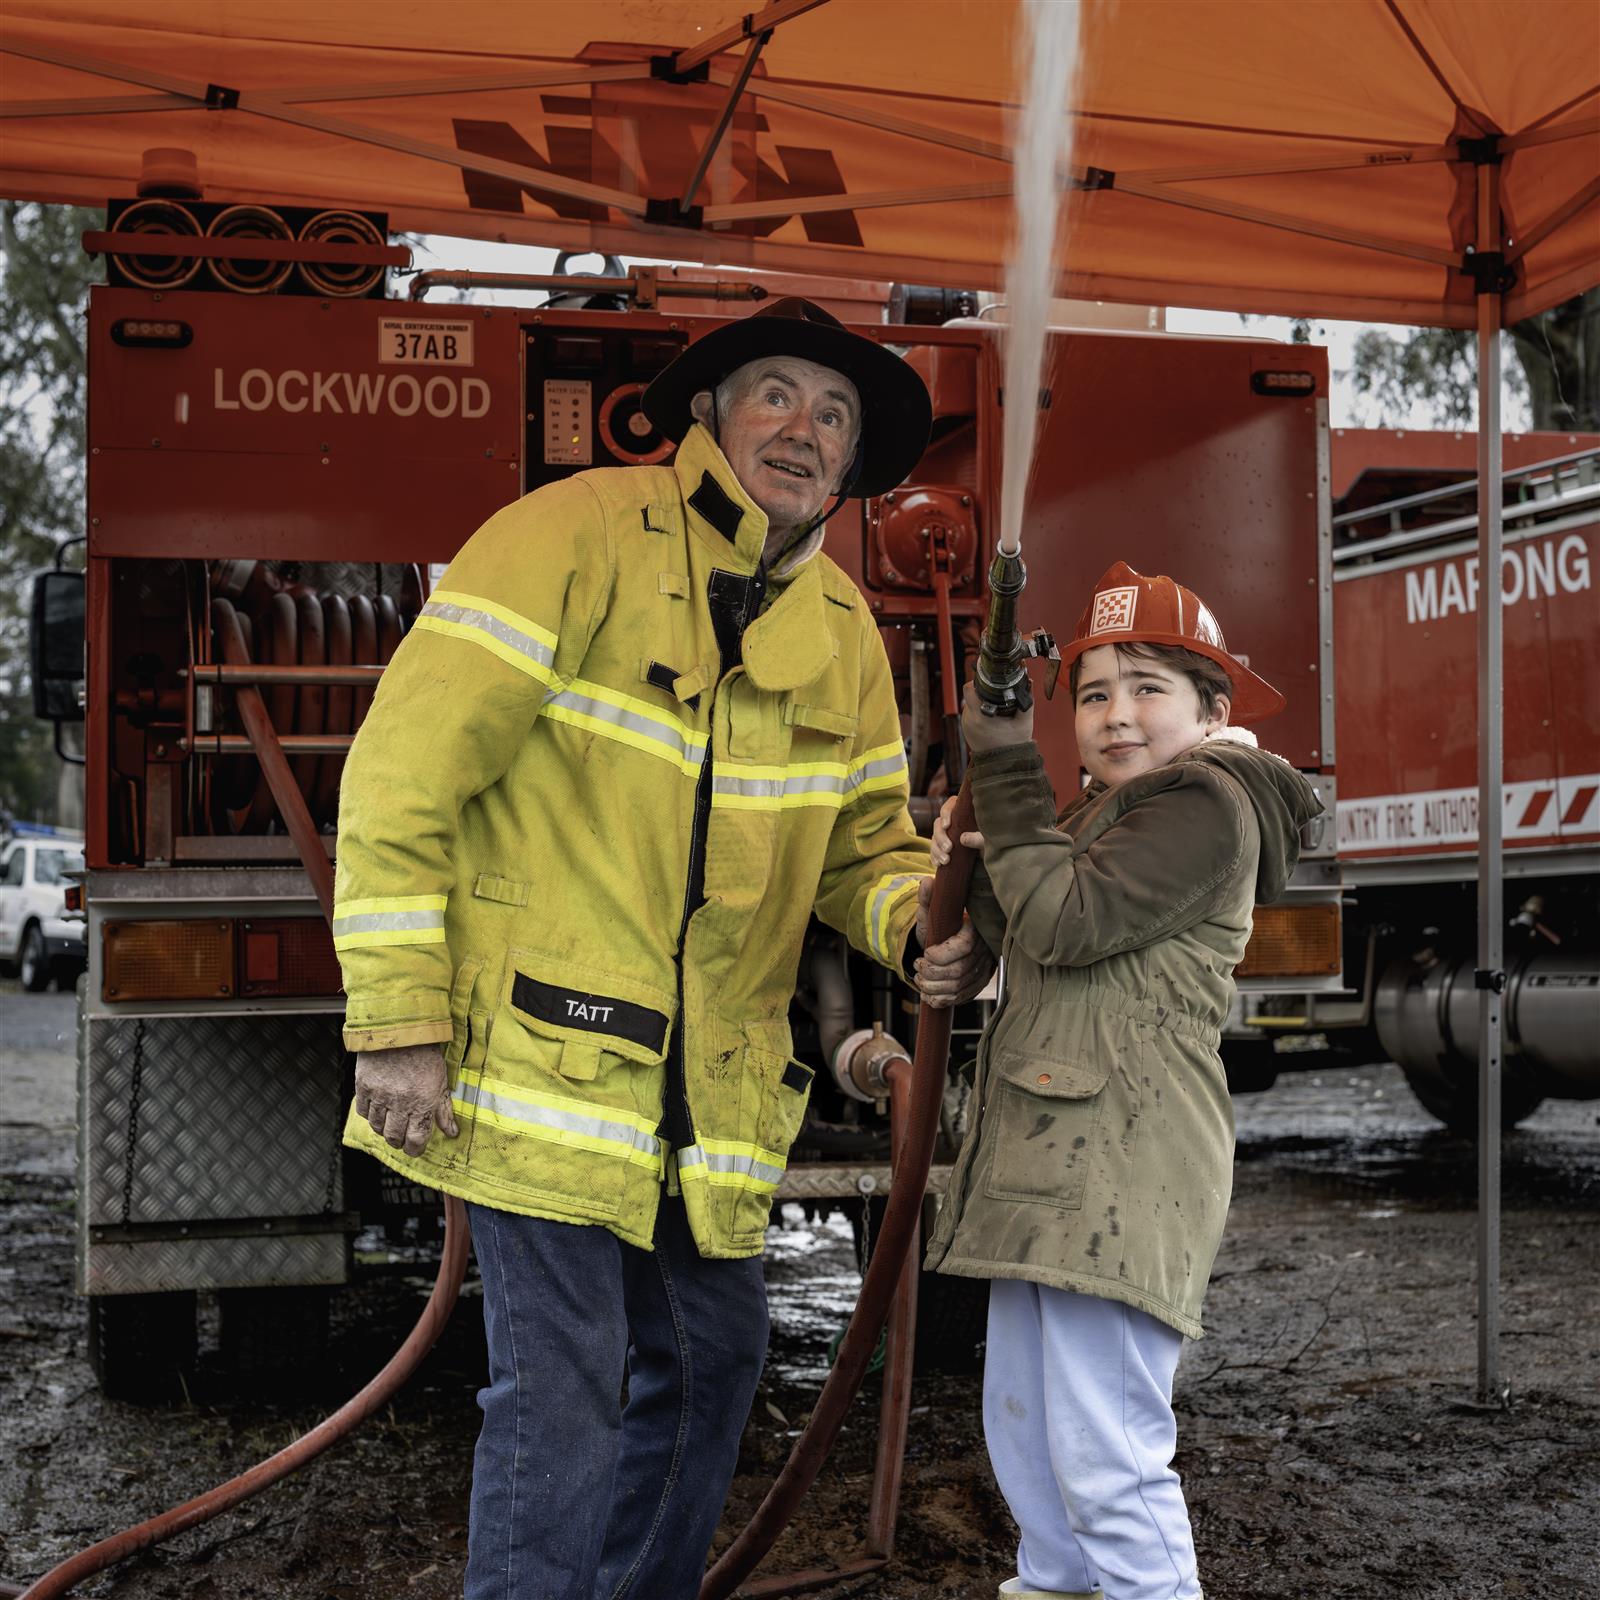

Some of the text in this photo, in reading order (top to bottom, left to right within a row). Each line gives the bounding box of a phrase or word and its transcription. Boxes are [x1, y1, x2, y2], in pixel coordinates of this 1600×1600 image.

[395, 333, 457, 360] 37AB
[214, 368, 491, 418] LOCKWOOD
[1097, 612, 1125, 628] CFA
[1387, 802, 1415, 838] FIRE
[566, 999, 614, 1023] TATT
